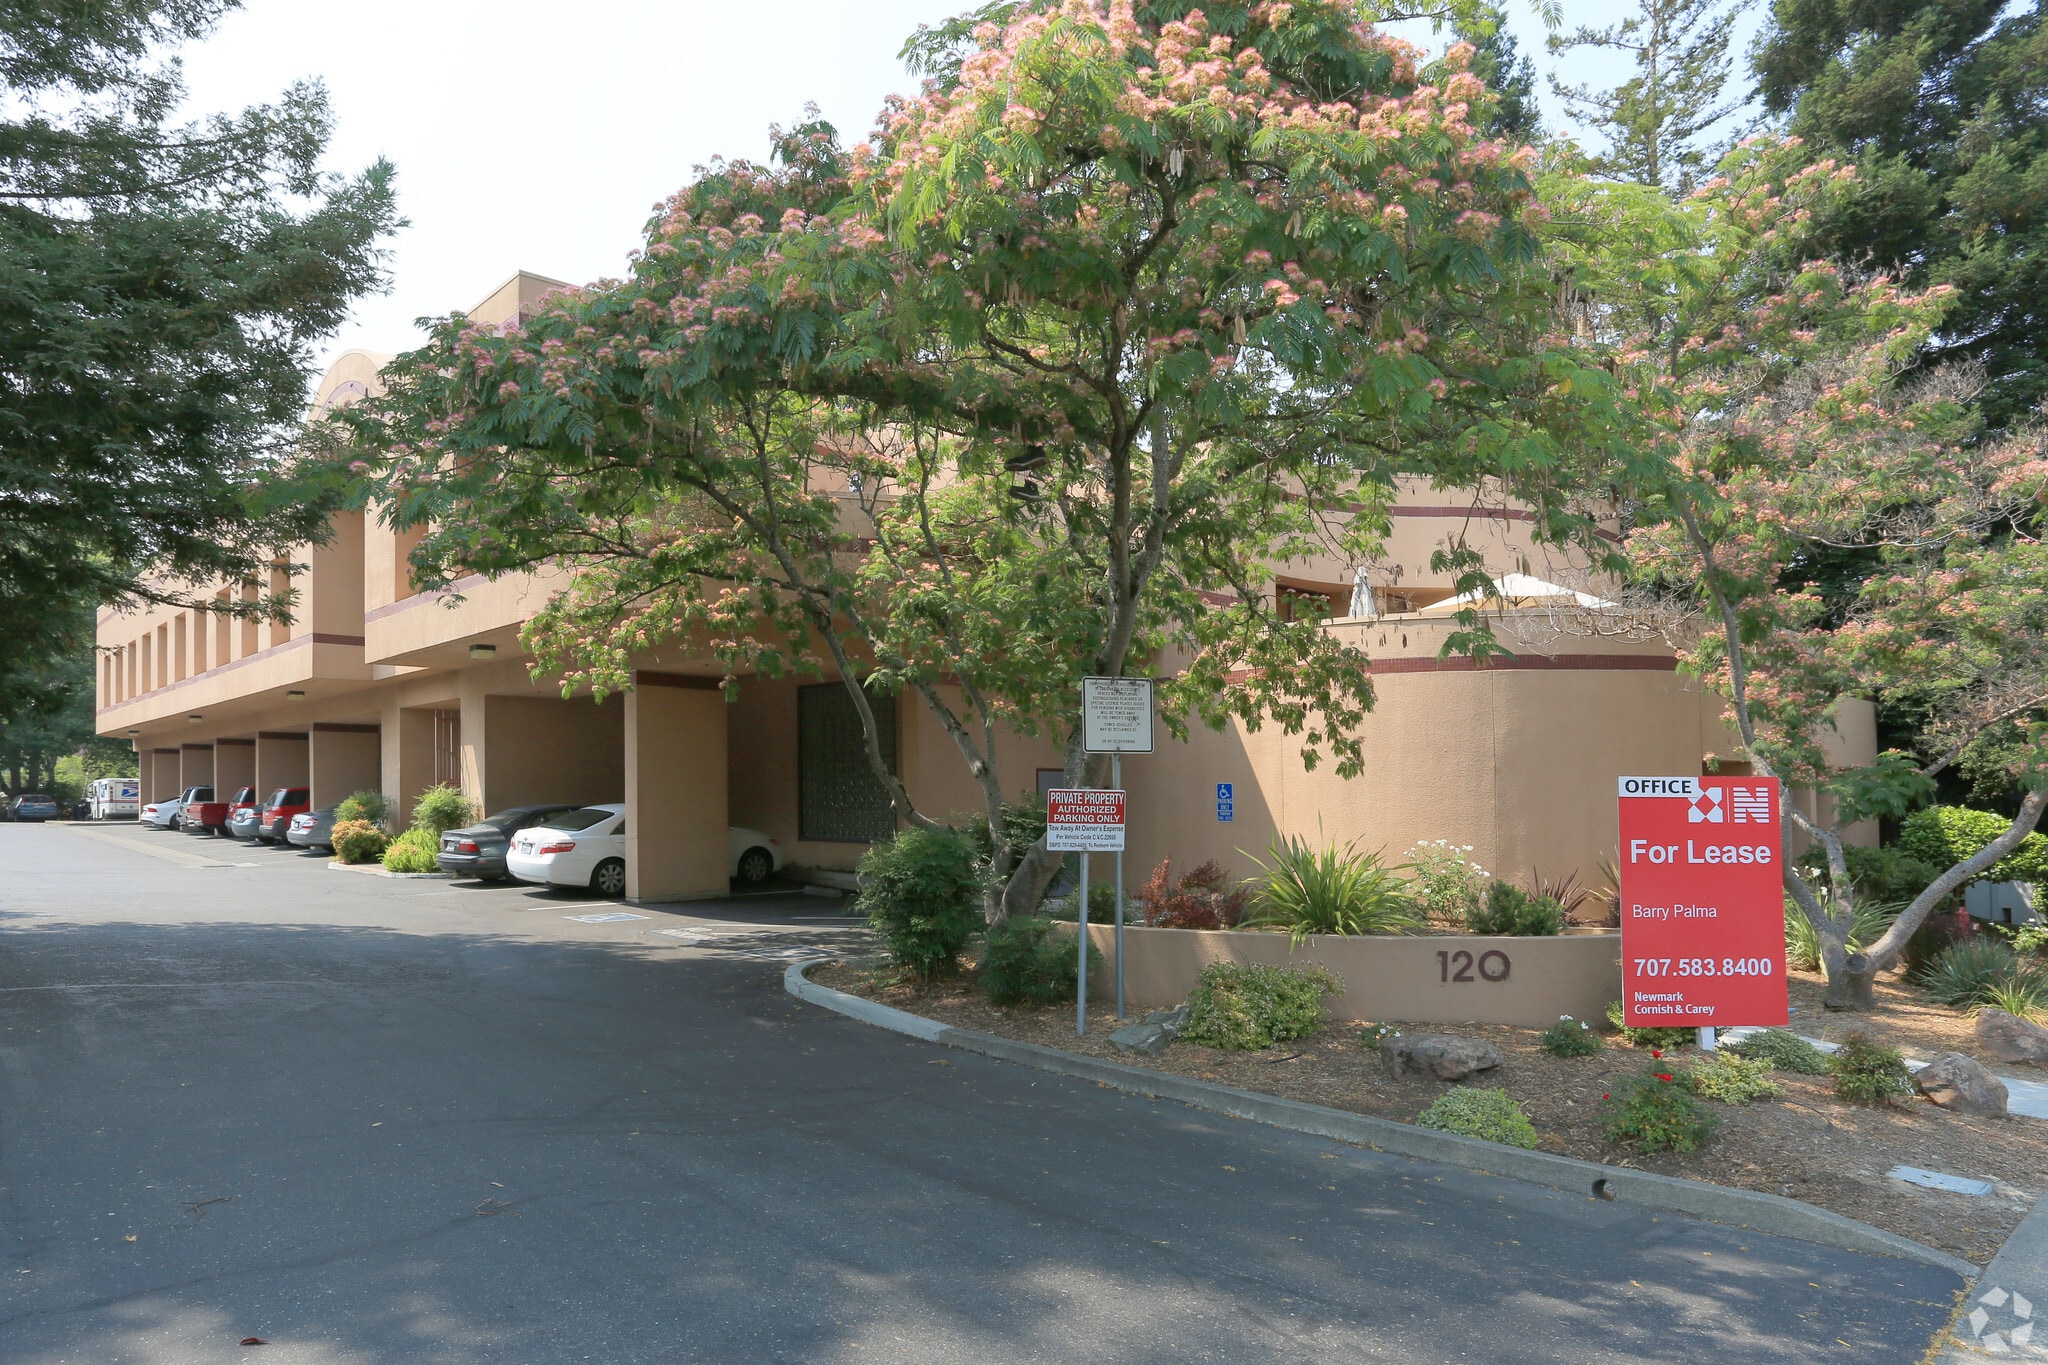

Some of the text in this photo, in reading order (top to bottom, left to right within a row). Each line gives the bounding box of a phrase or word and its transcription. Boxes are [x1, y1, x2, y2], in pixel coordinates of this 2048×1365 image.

[1625, 780, 1692, 794] OFFICE
[1050, 792, 1124, 804] PRIVATE PROPERTY
[1058, 805, 1117, 814] AUTHORIZED
[1054, 814, 1094, 822] PARKING
[1630, 840, 1771, 864] For Lease
[1633, 904, 1717, 921] Barry Palma
[1437, 950, 1511, 982] 120
[1634, 958, 1772, 977] 707.583.8400
[1634, 992, 1684, 1002] Newmark
[1634, 1004, 1715, 1016] Cornish & Carey
